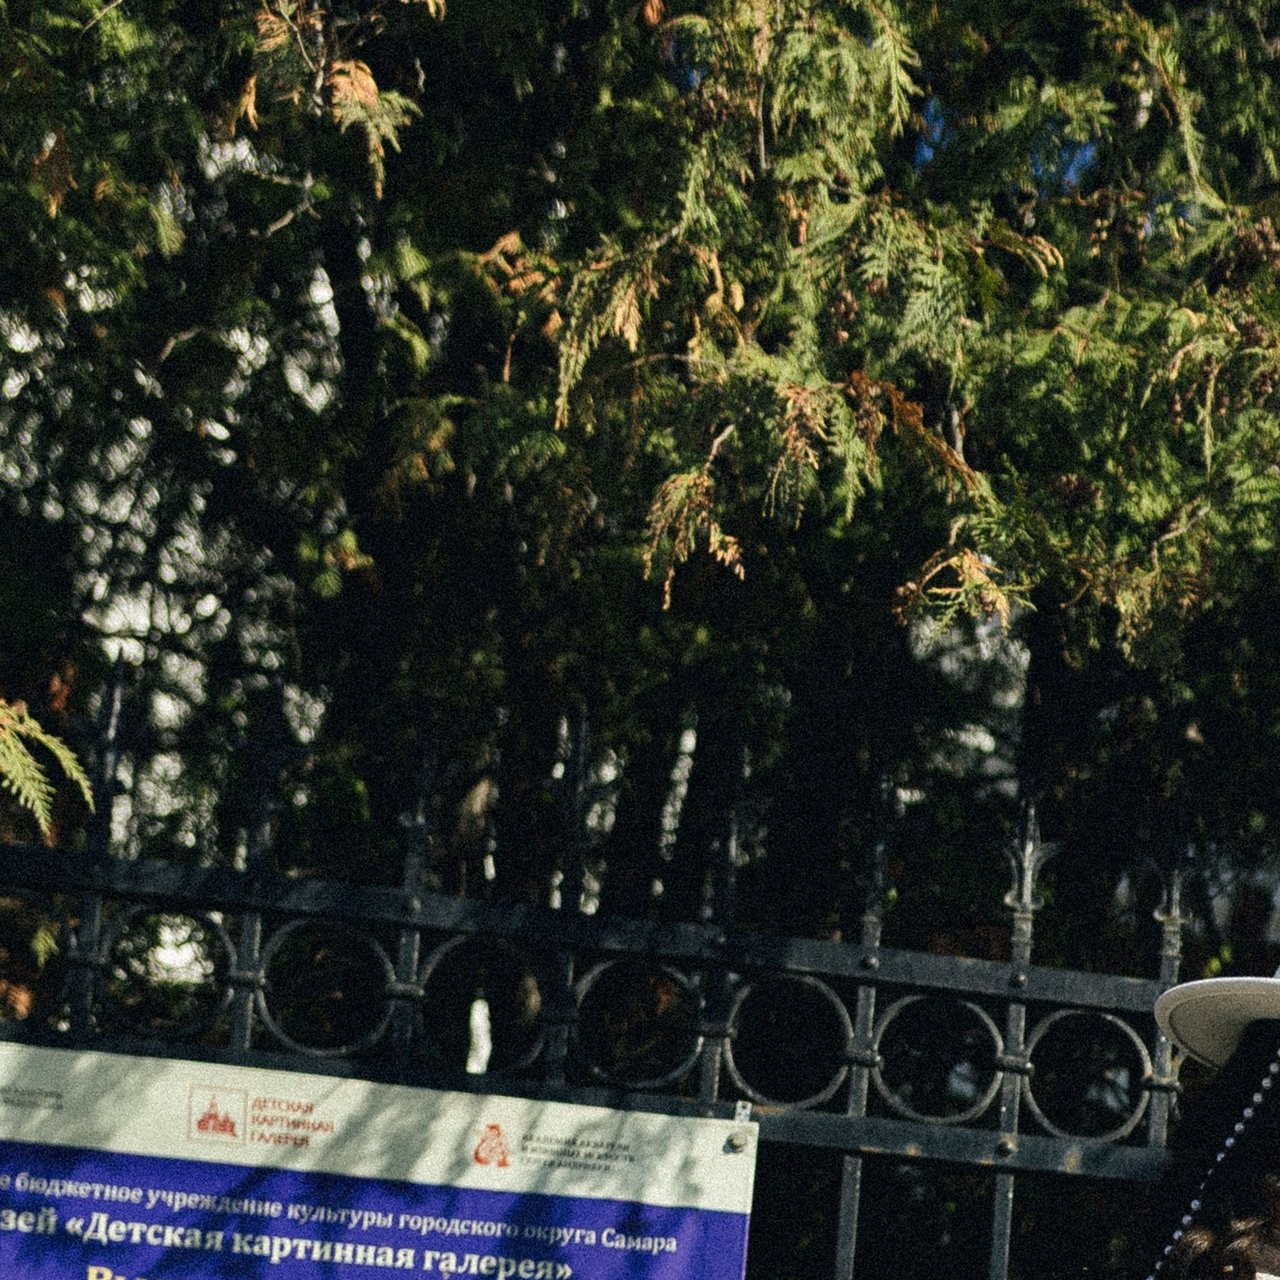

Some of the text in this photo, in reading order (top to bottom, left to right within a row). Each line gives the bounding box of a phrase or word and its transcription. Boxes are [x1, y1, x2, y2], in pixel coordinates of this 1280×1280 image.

[251, 1097, 314, 1113] ДЕТСКАЯ
[251, 1114, 334, 1133] КАРТИННАЯ
[250, 1131, 309, 1147] ГАЛЕРЕЯ
[15, 1172, 143, 1203] бюджетное
[145, 1189, 283, 1219] учреждение
[287, 1203, 393, 1230] культуры
[398, 1213, 518, 1238] городского
[523, 1226, 596, 1246] округа
[601, 1228, 677, 1255] Самара
[0, 1206, 58, 1236] зей
[65, 1211, 224, 1252] «Детская
[232, 1231, 415, 1269] картинная
